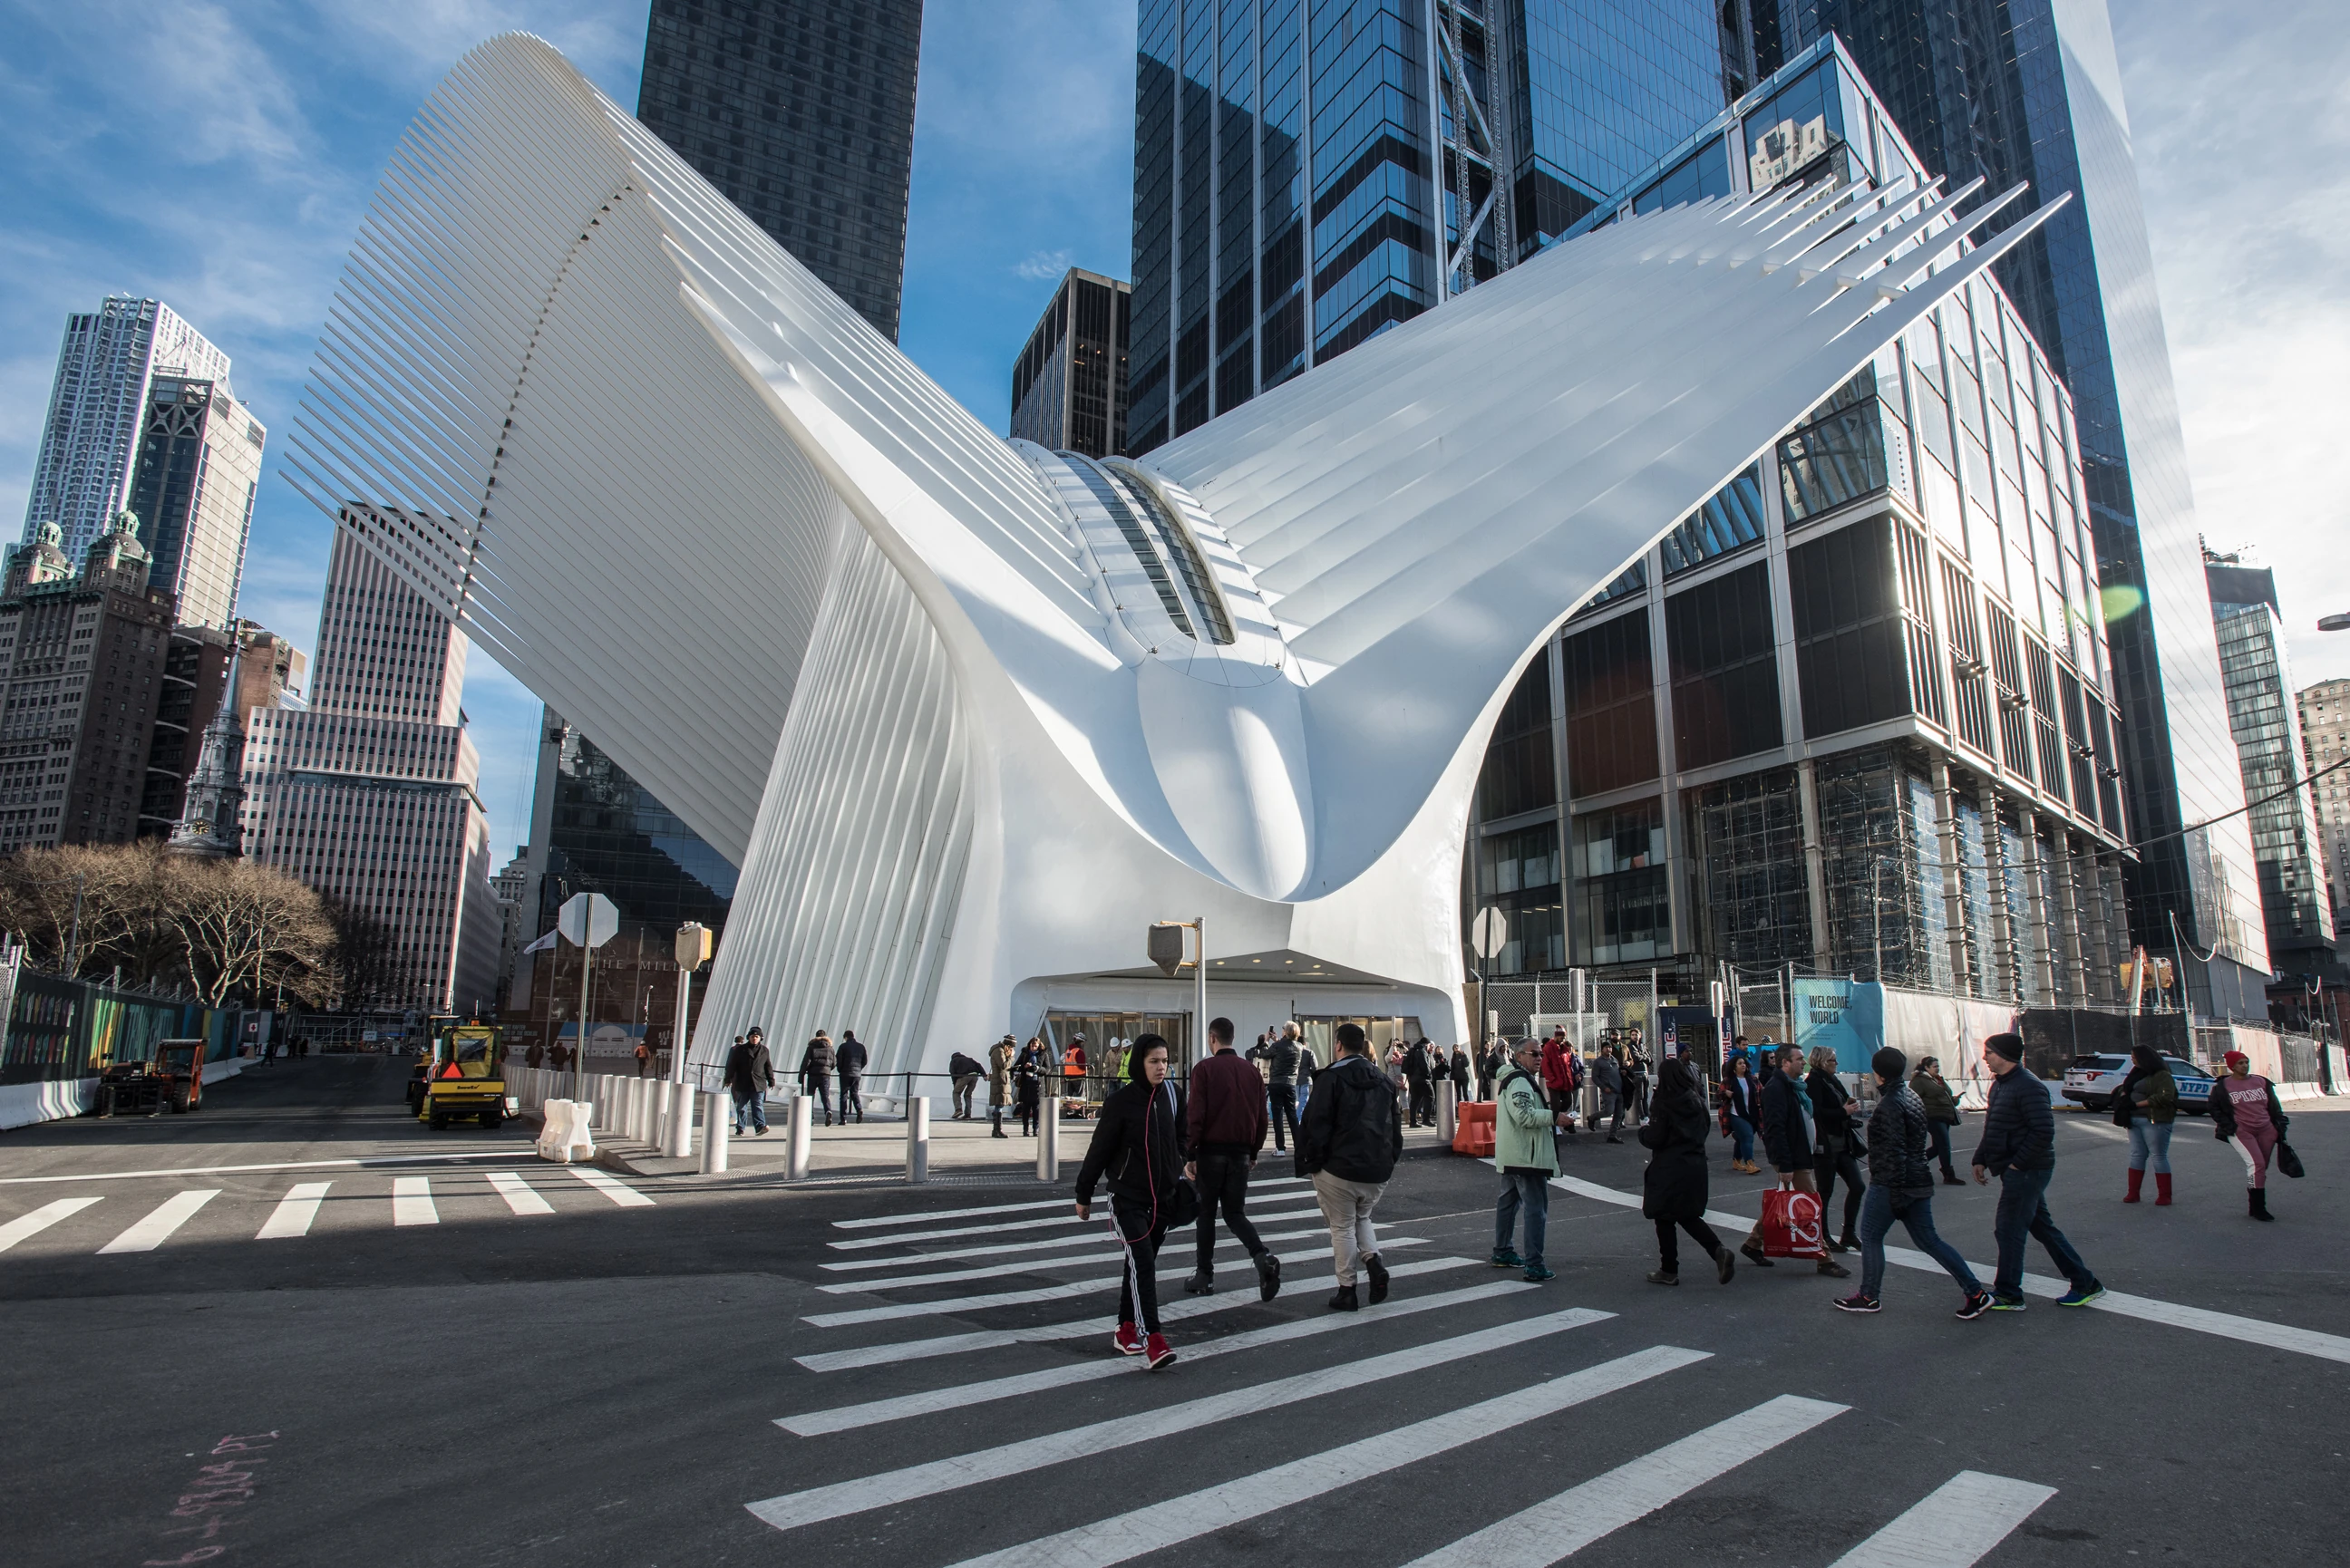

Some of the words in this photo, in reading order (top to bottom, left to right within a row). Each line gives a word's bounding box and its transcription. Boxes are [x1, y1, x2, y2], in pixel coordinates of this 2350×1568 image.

[1809, 995, 1852, 1011] WELCOME,
[1810, 1011, 1840, 1024] WORLD
[2180, 1082, 2209, 1094] NYPD
